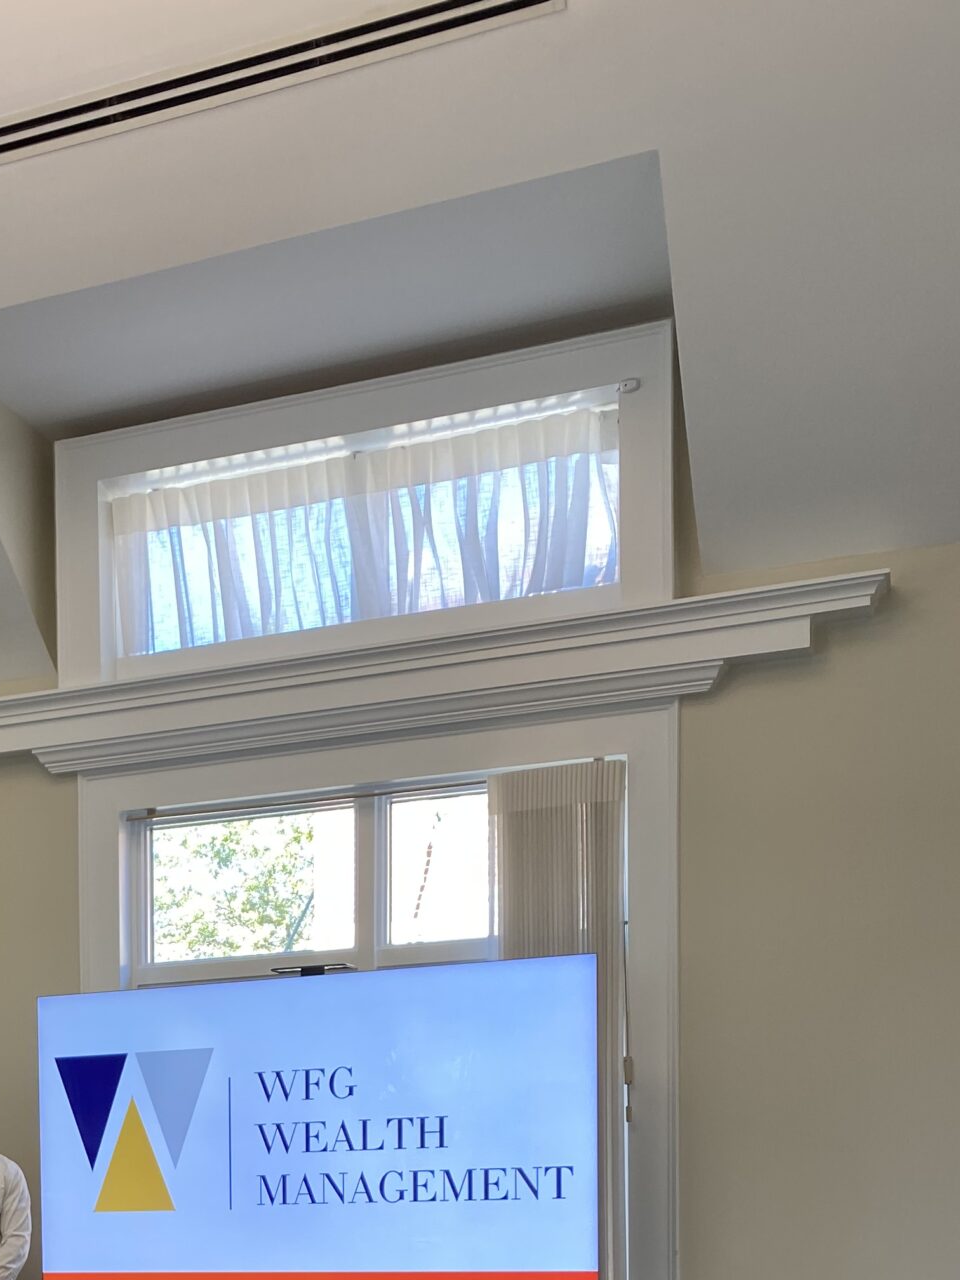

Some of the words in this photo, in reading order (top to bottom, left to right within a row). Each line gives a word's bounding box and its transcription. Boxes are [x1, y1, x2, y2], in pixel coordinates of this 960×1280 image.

[254, 1066, 357, 1103] WFG
[254, 1115, 449, 1155] WEALTH
[256, 1165, 575, 1206] MANAGEMENT
